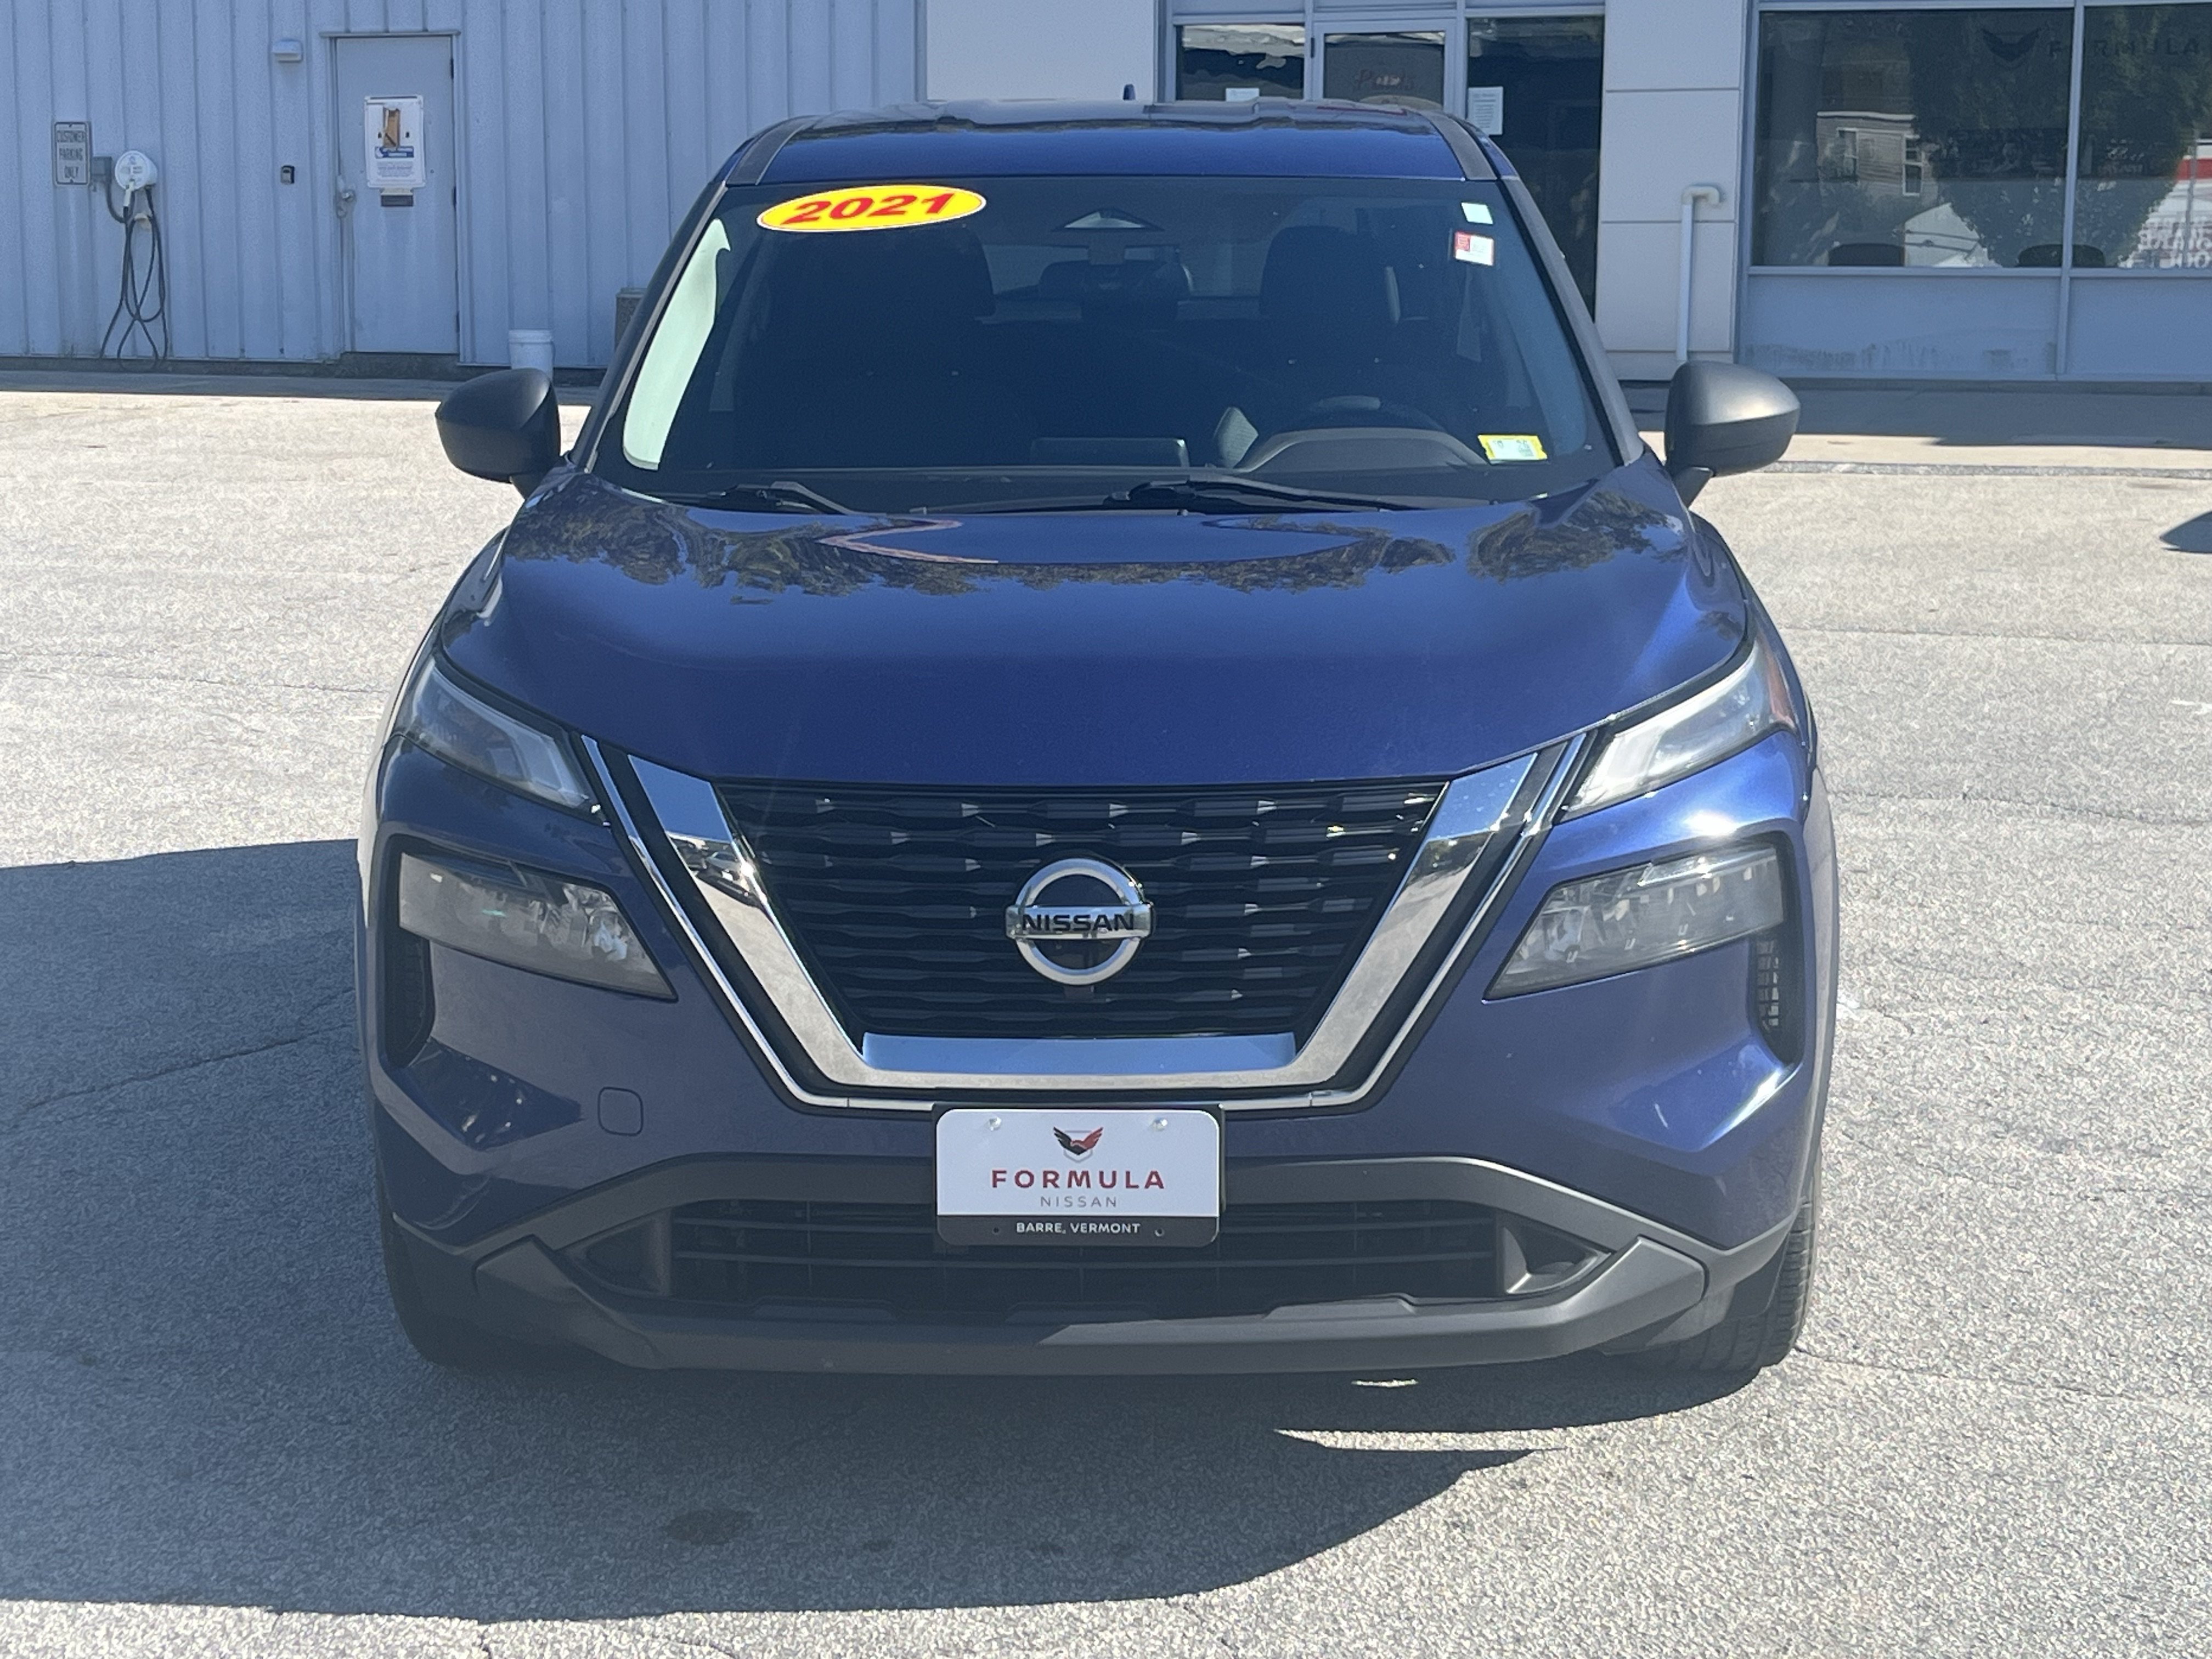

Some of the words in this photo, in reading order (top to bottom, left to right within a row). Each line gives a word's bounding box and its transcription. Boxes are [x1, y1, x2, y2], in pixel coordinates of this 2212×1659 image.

[2049, 38, 2200, 56] FRMULA
[64, 166, 79, 178] ONLY
[780, 193, 955, 225] 2021
[1022, 913, 1134, 931] NISSAN
[991, 1170, 1164, 1189] FORMULA
[1040, 1195, 1116, 1207] NISSAN
[1017, 1222, 1066, 1234] BARRE,
[1070, 1222, 1141, 1233] VERMONT
